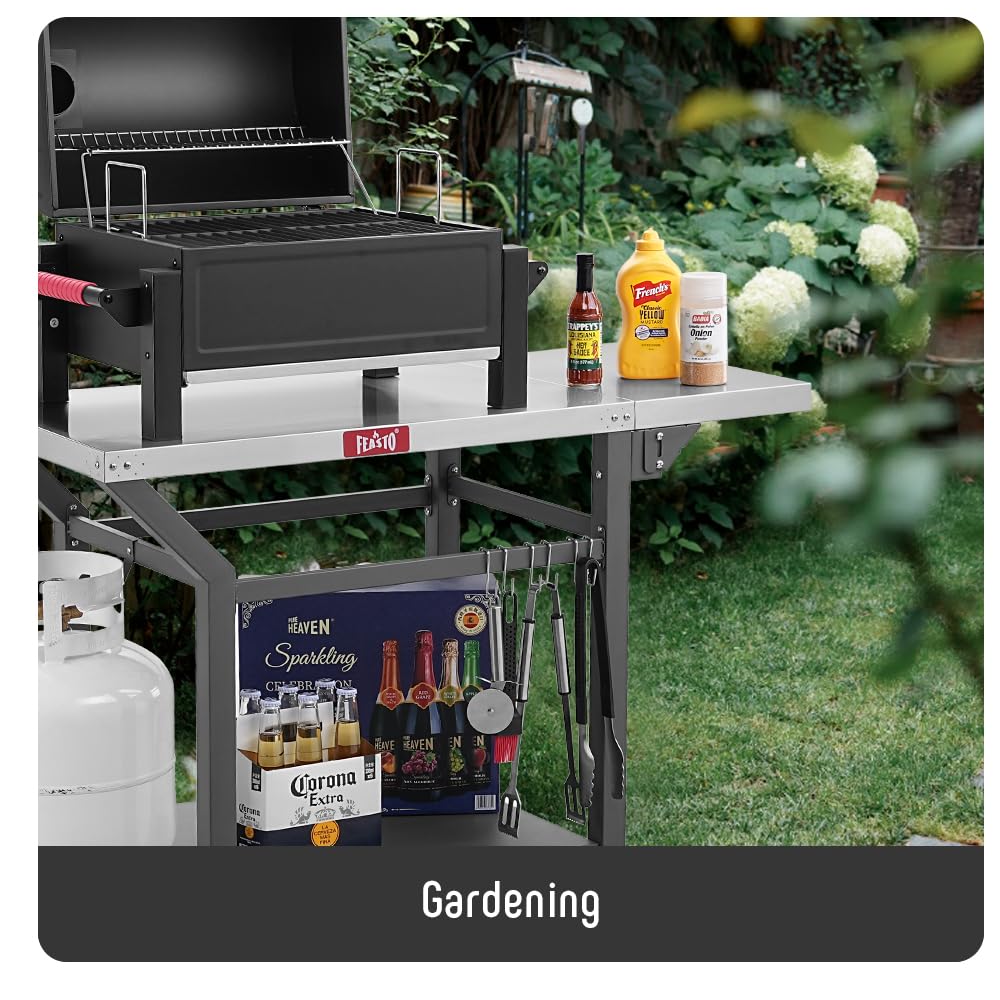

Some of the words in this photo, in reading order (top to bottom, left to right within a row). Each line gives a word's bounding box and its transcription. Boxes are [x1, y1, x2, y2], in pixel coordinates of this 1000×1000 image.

[634, 283, 669, 300] French's
[639, 309, 665, 320] YELLOW
[690, 329, 713, 337] Onion
[288, 618, 330, 635] HEAVEN
[265, 642, 358, 673] Sparkling
[374, 740, 395, 751] HEAVE
[290, 771, 357, 799] Corona
[309, 793, 344, 807] Extra
[238, 803, 261, 817] Corona
